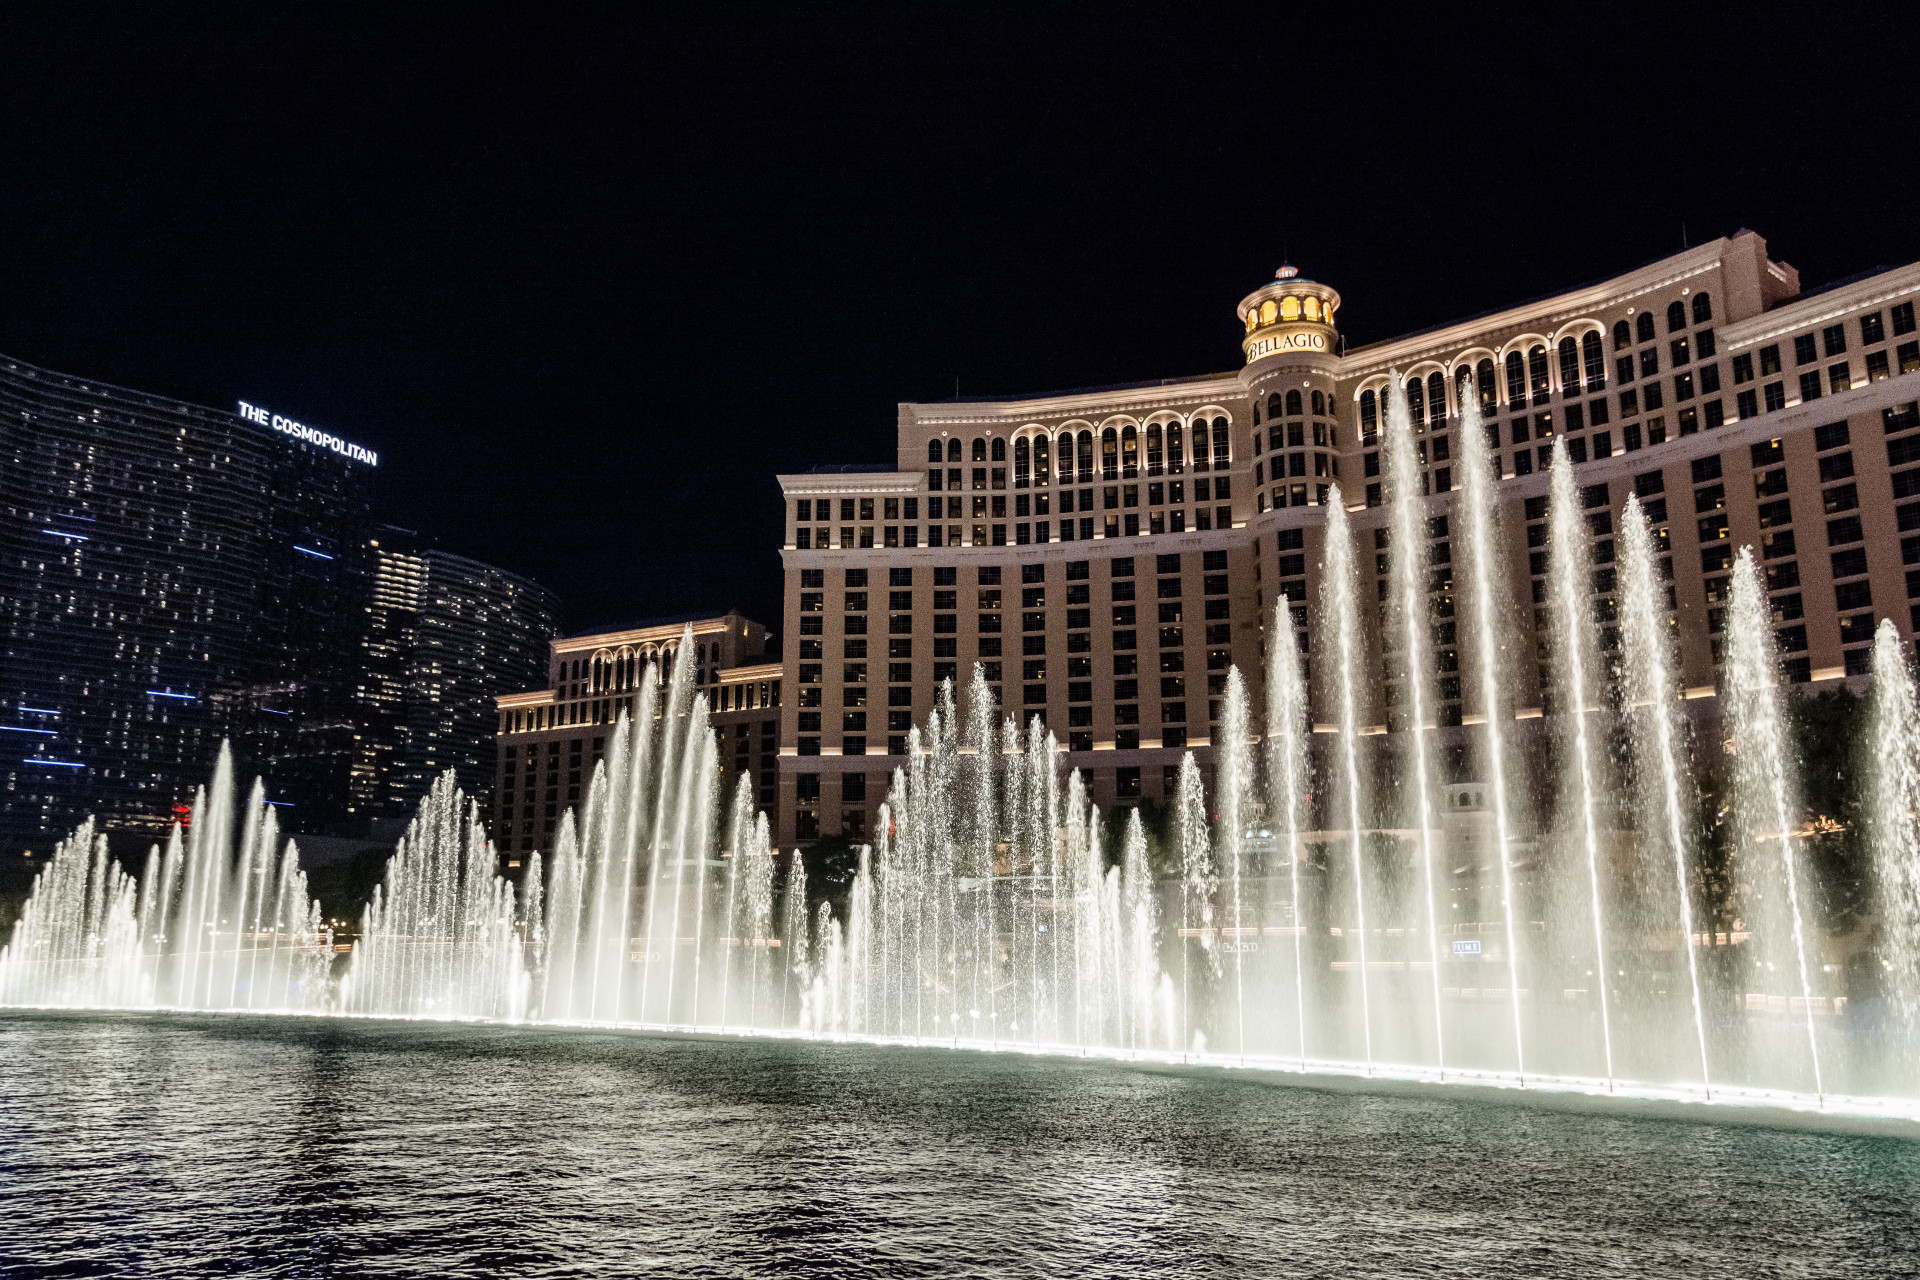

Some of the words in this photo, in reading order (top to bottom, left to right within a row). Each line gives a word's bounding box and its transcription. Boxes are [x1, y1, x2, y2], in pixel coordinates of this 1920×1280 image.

[1246, 333, 1325, 364] BELLAGIO
[238, 400, 270, 426] THE
[272, 414, 377, 467] COSMOPOLITAN
